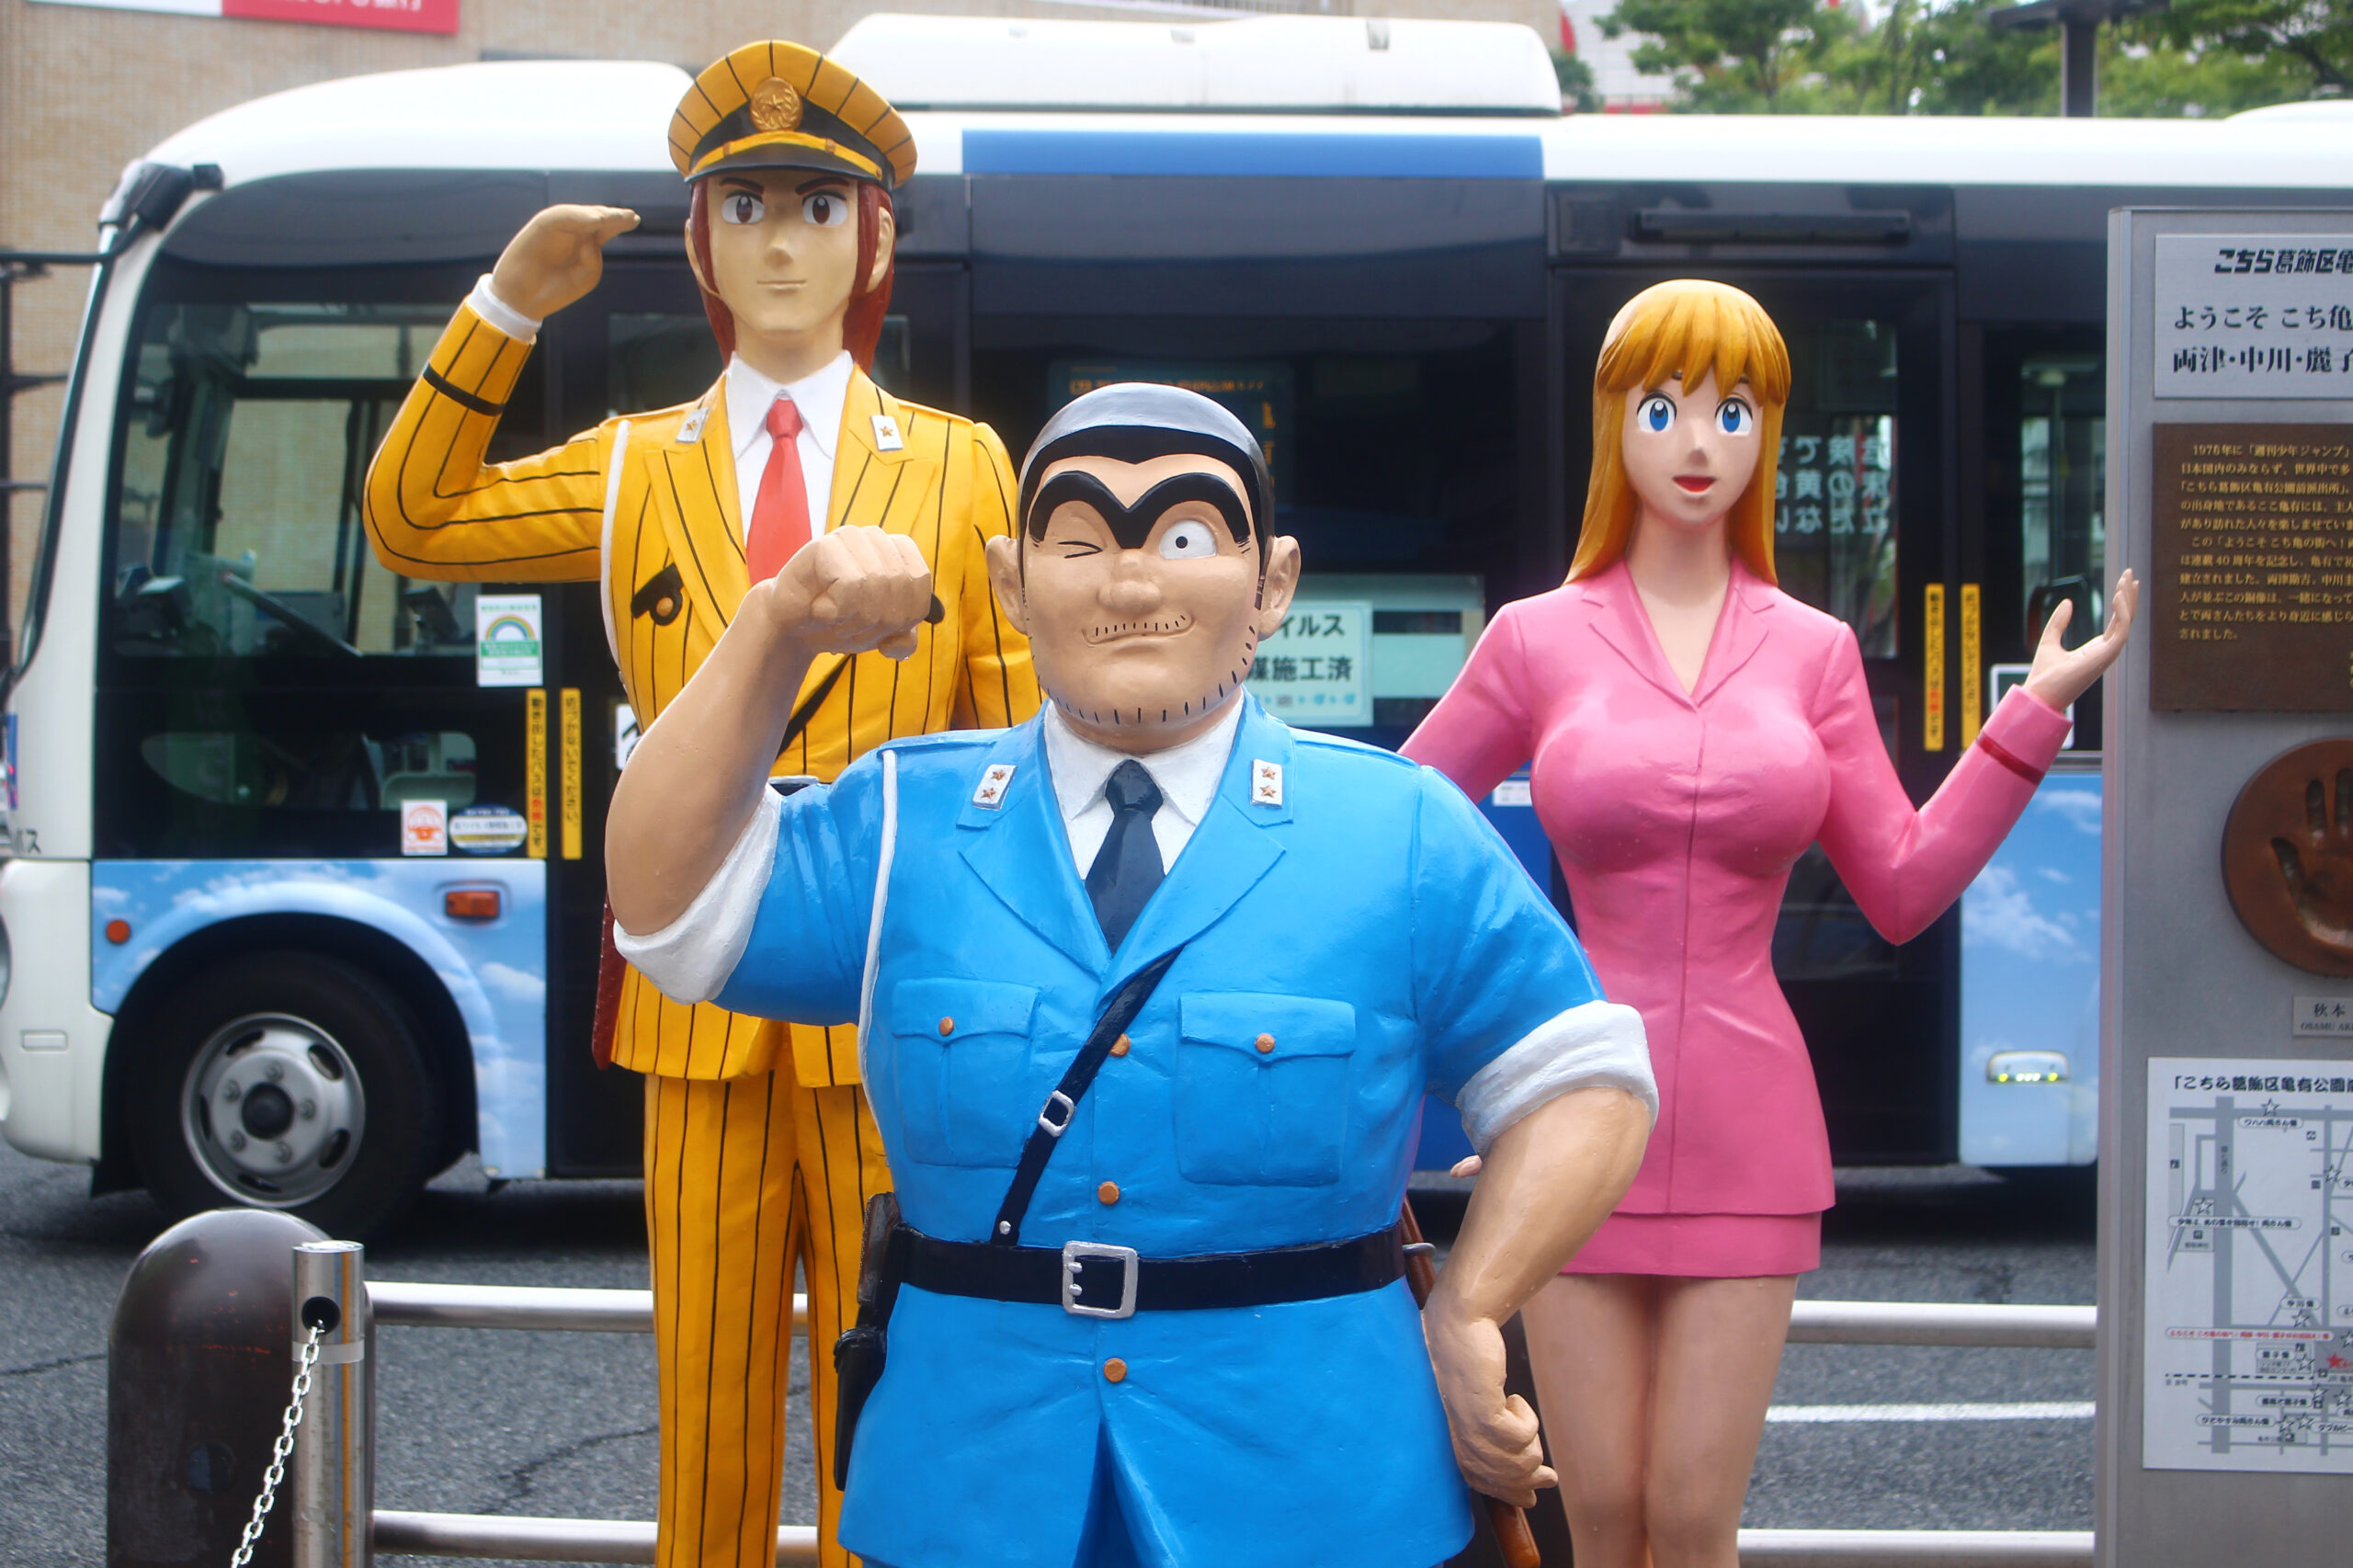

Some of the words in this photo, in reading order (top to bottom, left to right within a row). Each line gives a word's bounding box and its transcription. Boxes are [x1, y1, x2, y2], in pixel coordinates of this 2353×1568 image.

[2214, 249, 2353, 273] こちら葛飾区亀
[2175, 306, 2268, 329] ようこそ
[2281, 305, 2353, 330] こち亀
